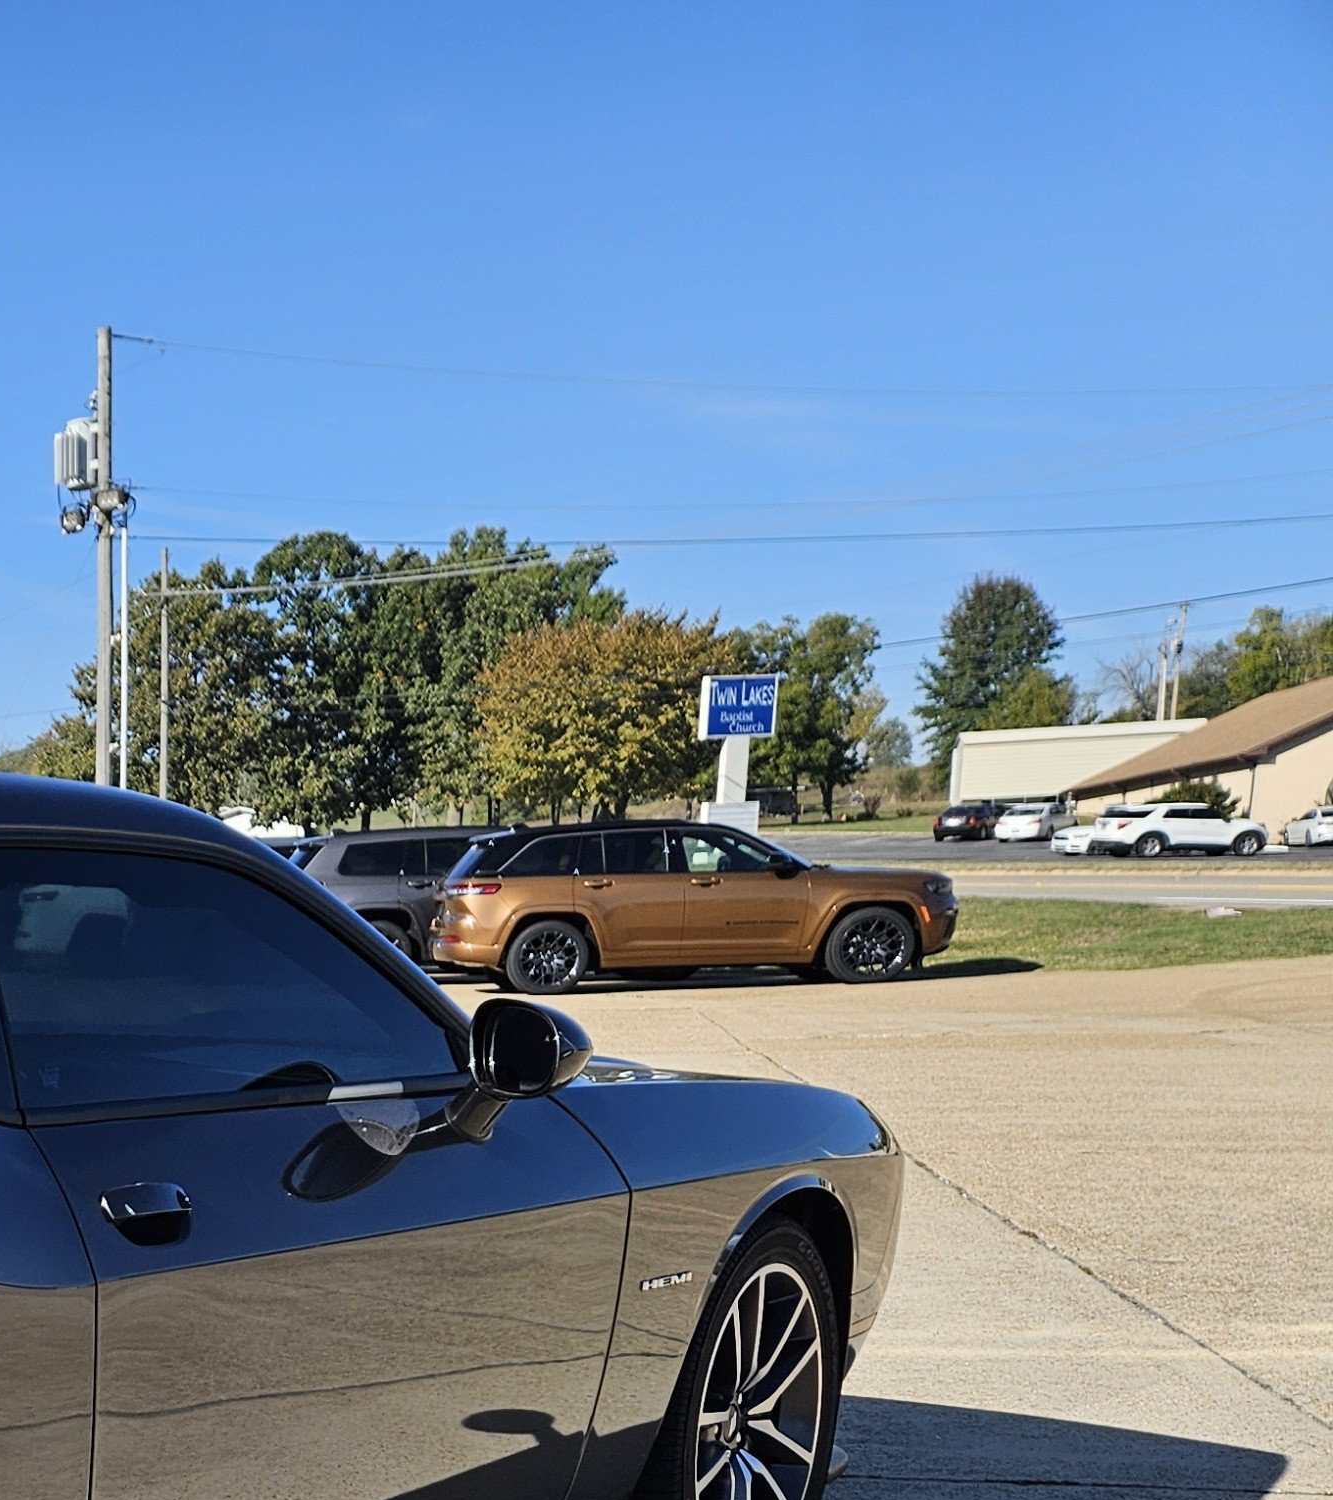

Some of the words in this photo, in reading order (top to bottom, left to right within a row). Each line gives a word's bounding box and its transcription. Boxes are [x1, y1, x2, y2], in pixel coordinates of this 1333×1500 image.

[711, 681, 738, 706] TWIN
[741, 680, 775, 707] LAKES
[720, 710, 754, 725] Baptist
[728, 720, 765, 733] Church
[641, 1271, 693, 1291] HEMI
